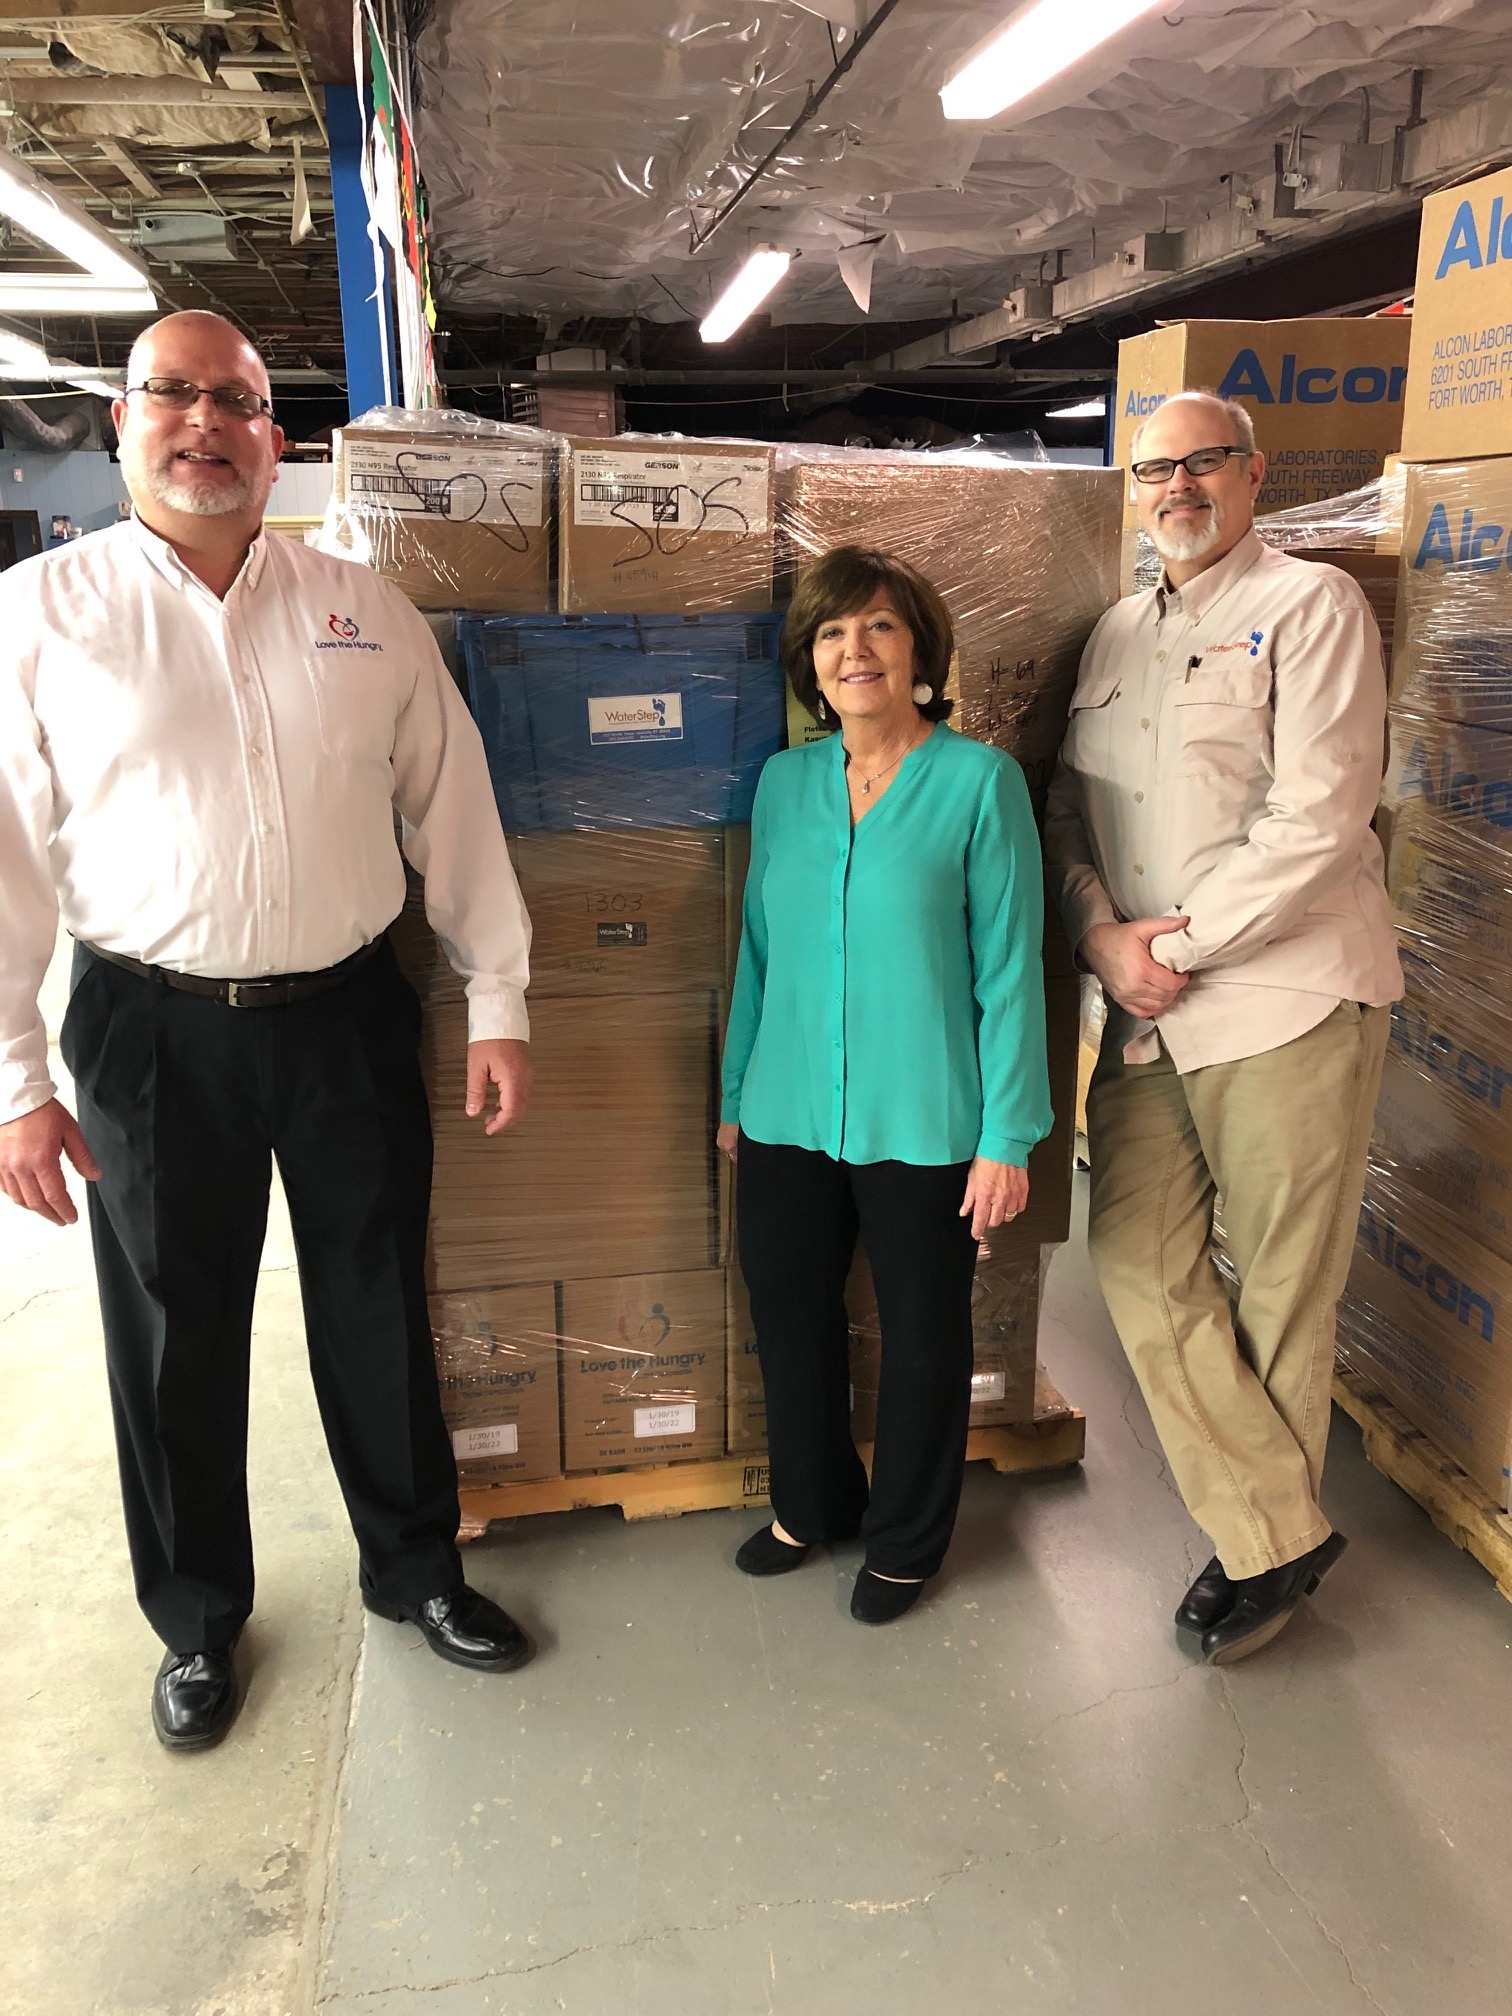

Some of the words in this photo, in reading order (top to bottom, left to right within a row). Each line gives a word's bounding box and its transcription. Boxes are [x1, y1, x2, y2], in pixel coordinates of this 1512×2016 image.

[1432, 333, 1471, 361] ALCON
[1431, 364, 1454, 386] 6201
[1457, 354, 1498, 381] SOUTH
[1428, 386, 1457, 410] FORT
[1460, 378, 1504, 405] WORTH,
[1268, 449, 1380, 467] LABORATORIES,
[350, 461, 366, 469] 2130
[368, 462, 382, 470] N95
[383, 463, 418, 472] Resprator
[580, 471, 597, 479] 2130
[1302, 468, 1371, 484] FREEWAY
[315, 640, 338, 649] Love
[338, 640, 353, 649] the
[604, 709, 660, 722] WaterStep
[599, 928, 630, 937] WaterStep
[1358, 1194, 1495, 1343] Alcon
[580, 1358, 618, 1373] Love
[620, 1356, 647, 1370] the
[649, 1352, 706, 1368] Hungry
[649, 1409, 680, 1420] 1/30/19
[649, 1419, 680, 1429] 1/30/22
[468, 1430, 501, 1441] 1/30/19
